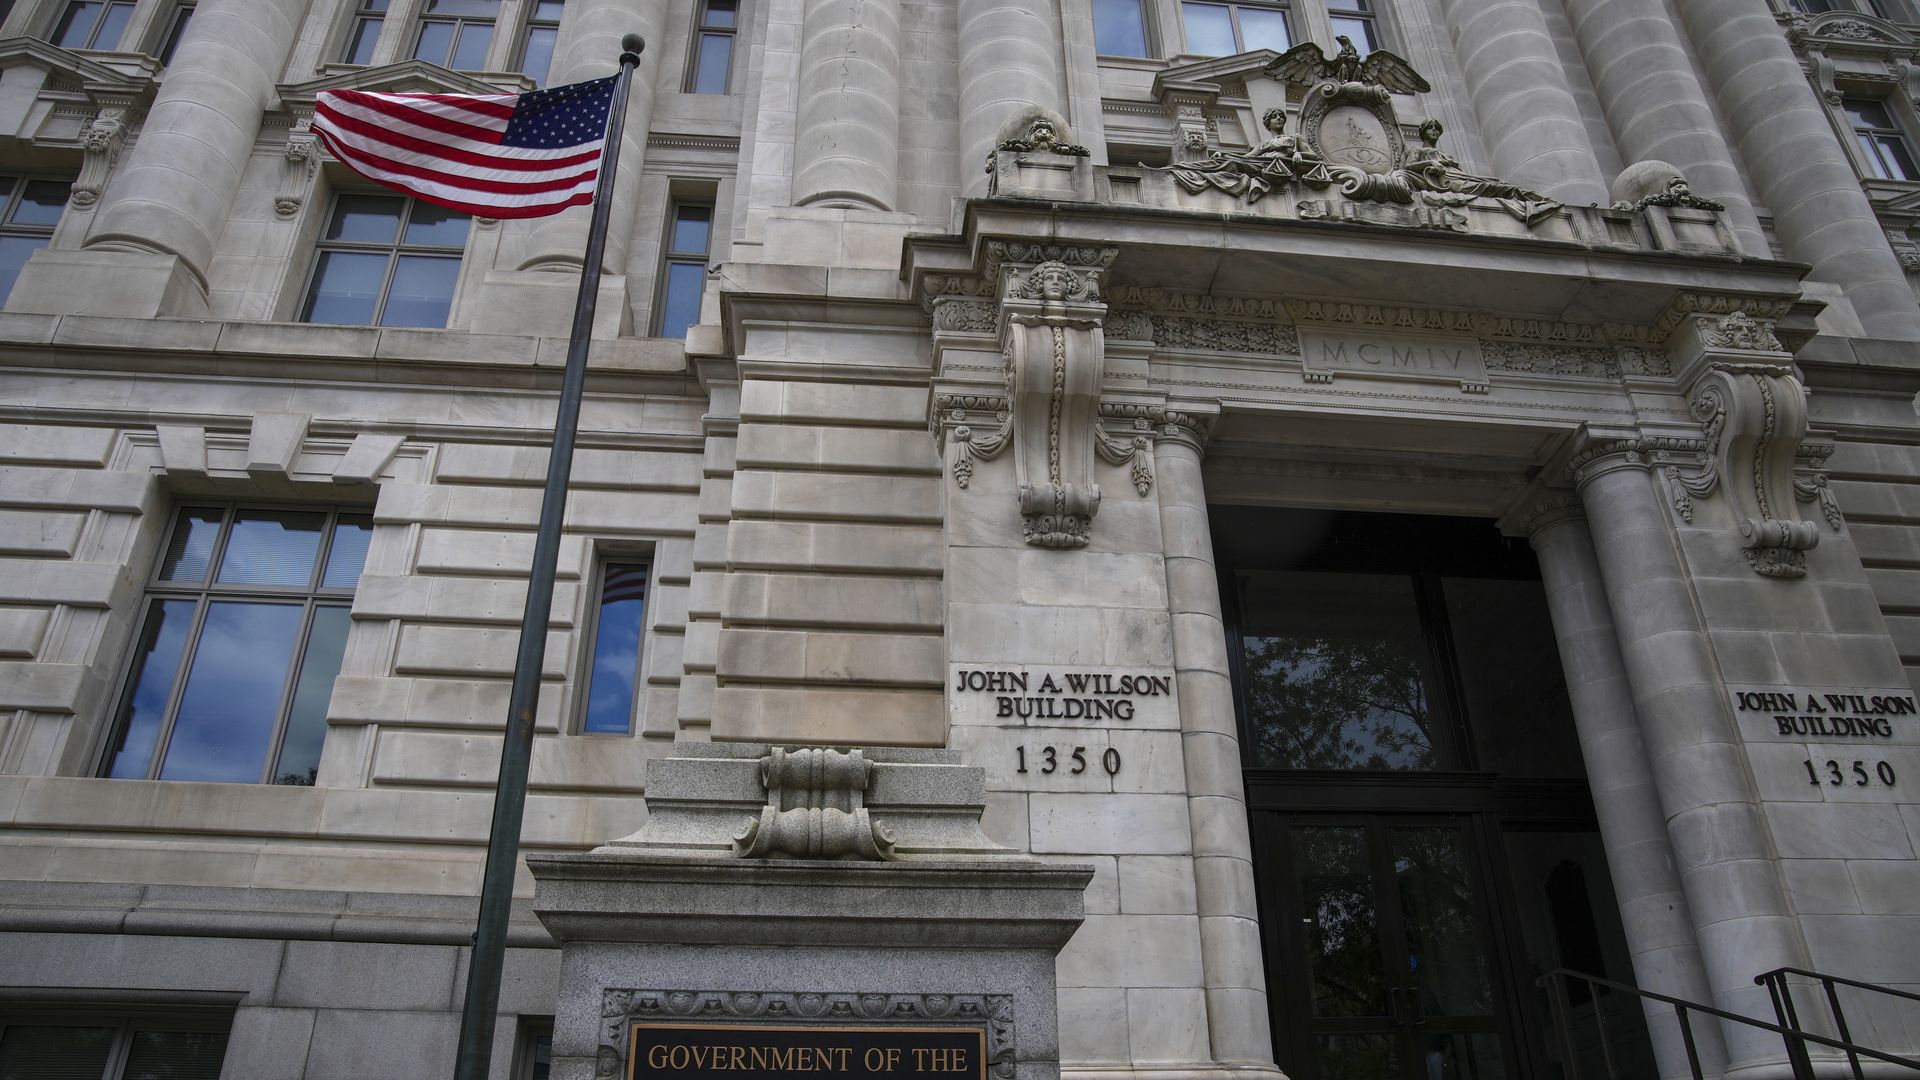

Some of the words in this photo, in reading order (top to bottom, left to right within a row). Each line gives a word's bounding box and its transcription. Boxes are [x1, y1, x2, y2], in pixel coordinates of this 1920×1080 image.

[1321, 339, 1462, 370] MCMIV
[957, 671, 1028, 692] JOHN
[1065, 673, 1171, 696] WILSON
[996, 697, 1135, 720] BUILDING
[1736, 692, 1798, 712] JOHN
[1824, 694, 1917, 715] WILSON
[1774, 715, 1893, 737] BUILDING
[1016, 745, 1121, 775] 1350
[1803, 759, 1896, 786] 1350
[648, 1044, 853, 1073] GOVERNMENT
[864, 1046, 902, 1073] OF
[912, 1047, 968, 1073] THE
